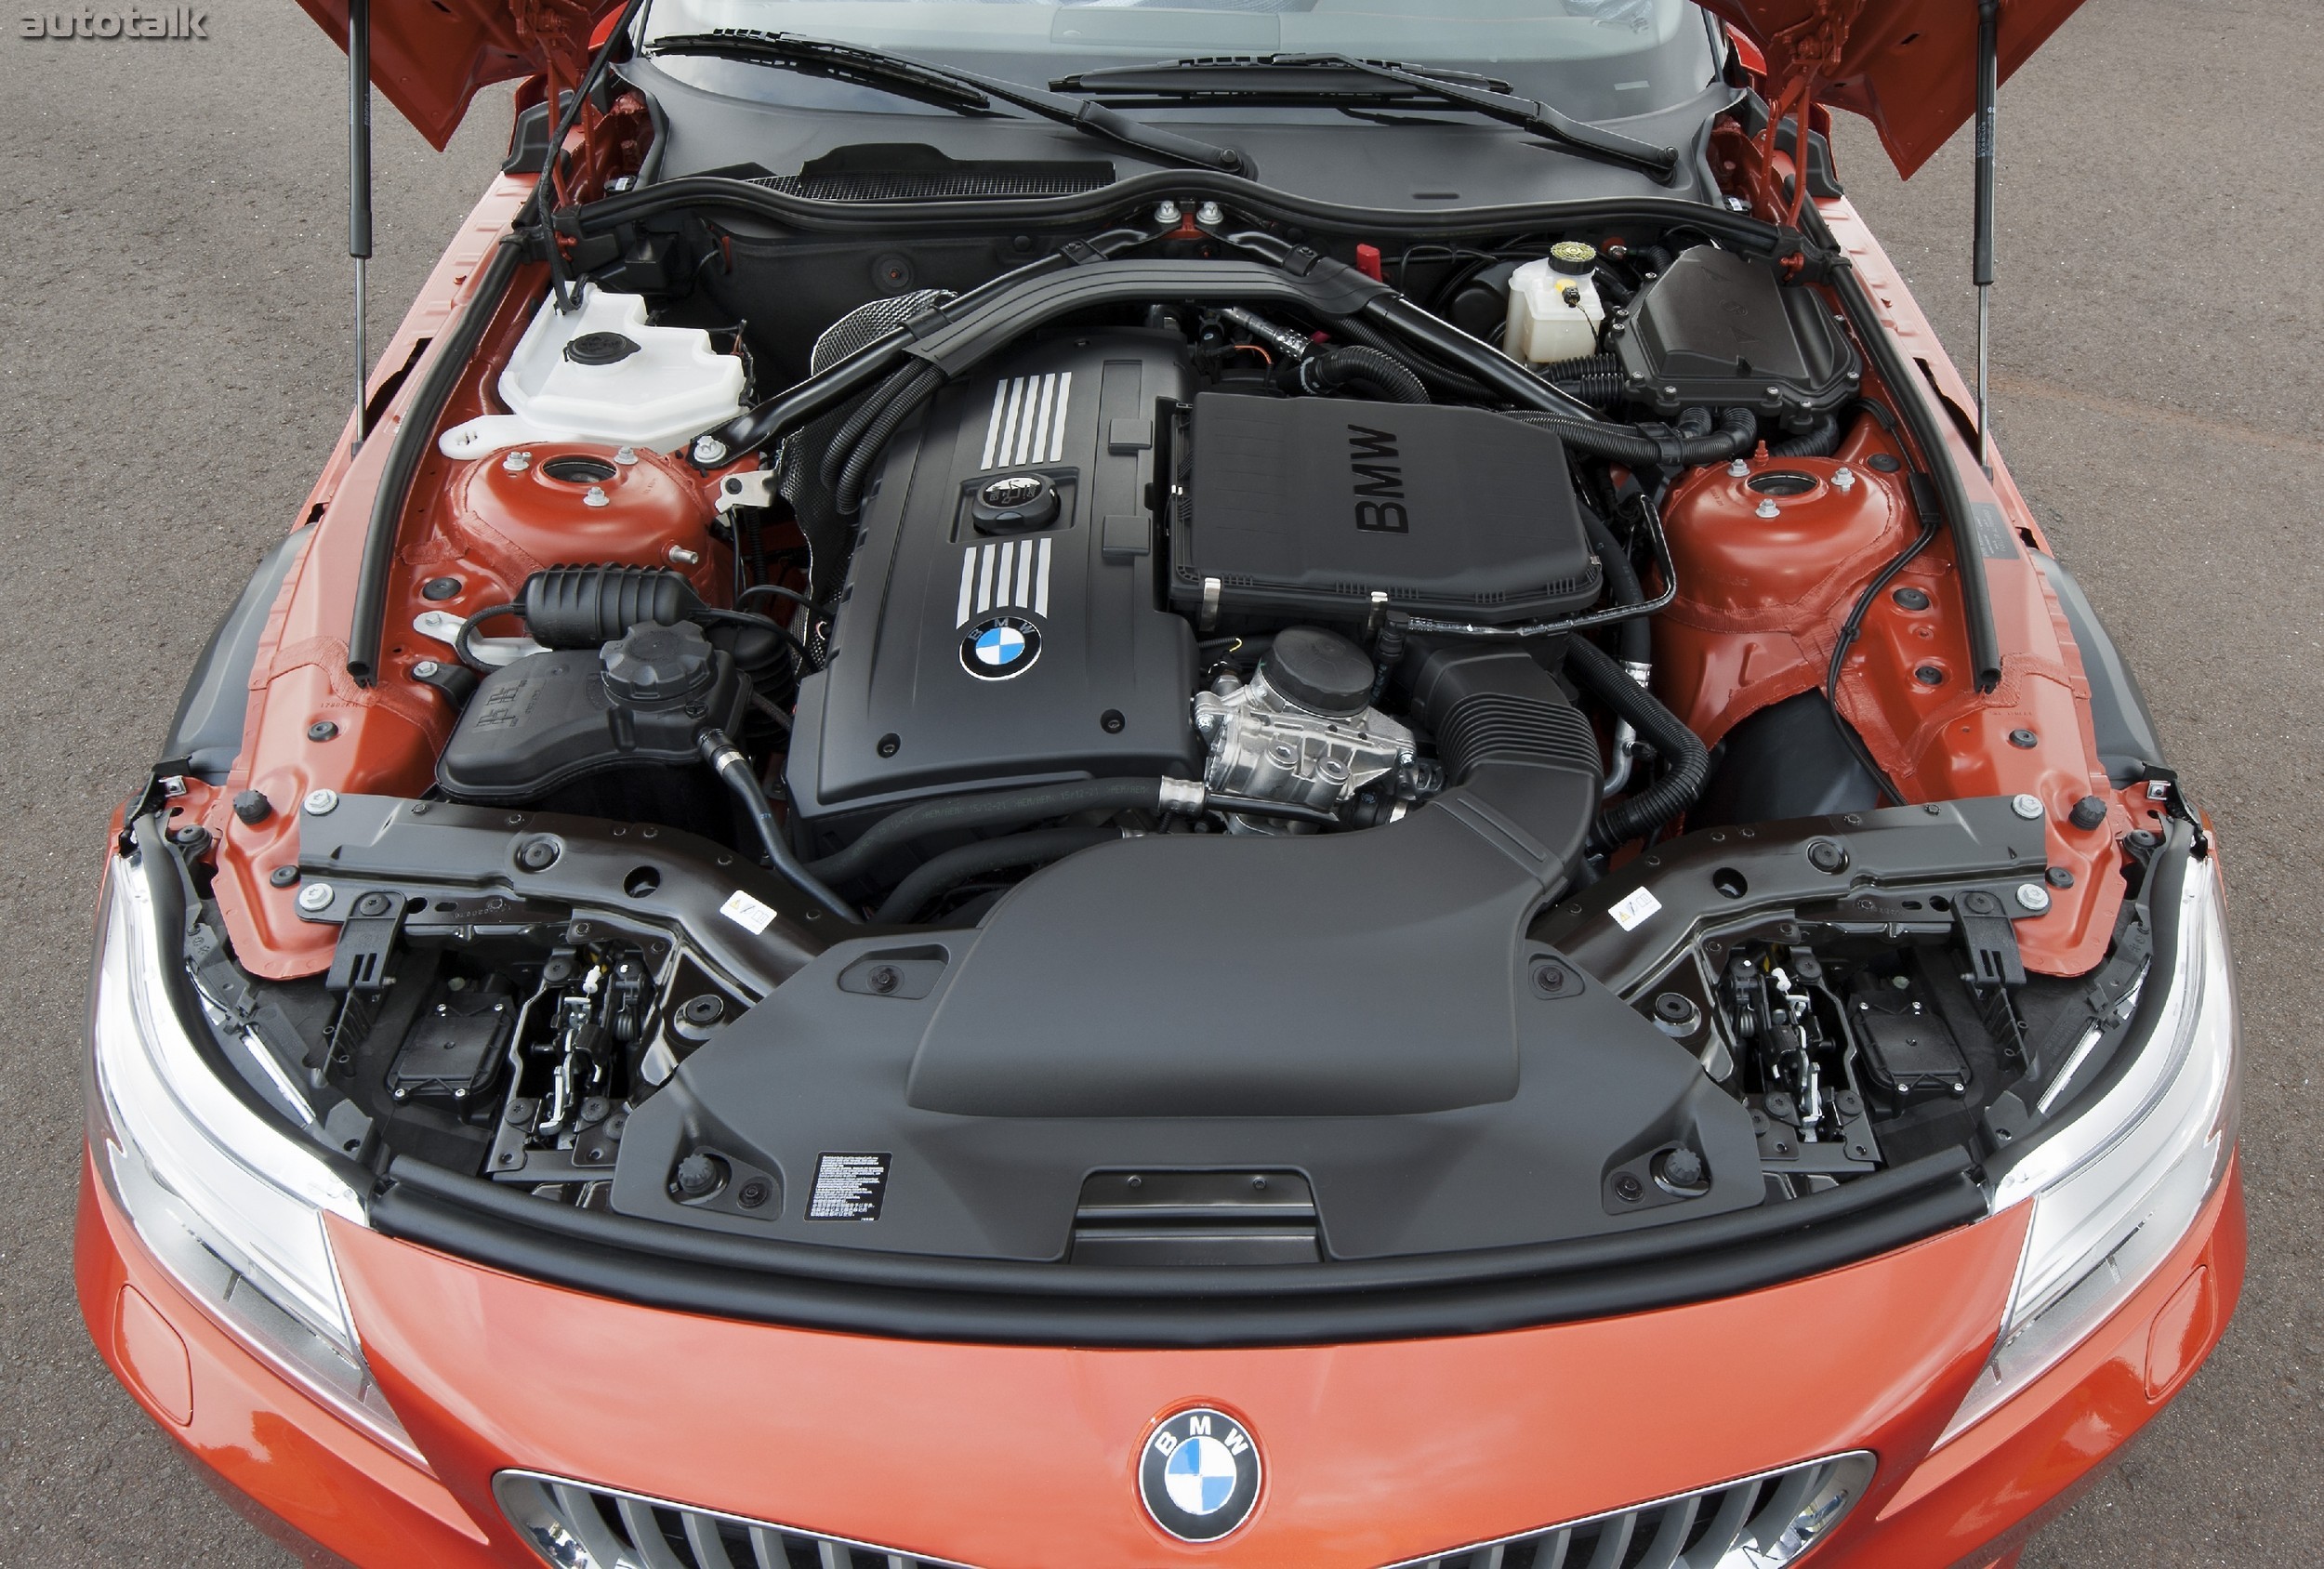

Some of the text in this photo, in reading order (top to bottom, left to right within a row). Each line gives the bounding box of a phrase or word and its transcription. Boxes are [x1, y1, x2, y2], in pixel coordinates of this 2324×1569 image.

[1347, 424, 1409, 534] BMW
[967, 617, 1036, 641] BMW
[1154, 1415, 1249, 1457] BMW
